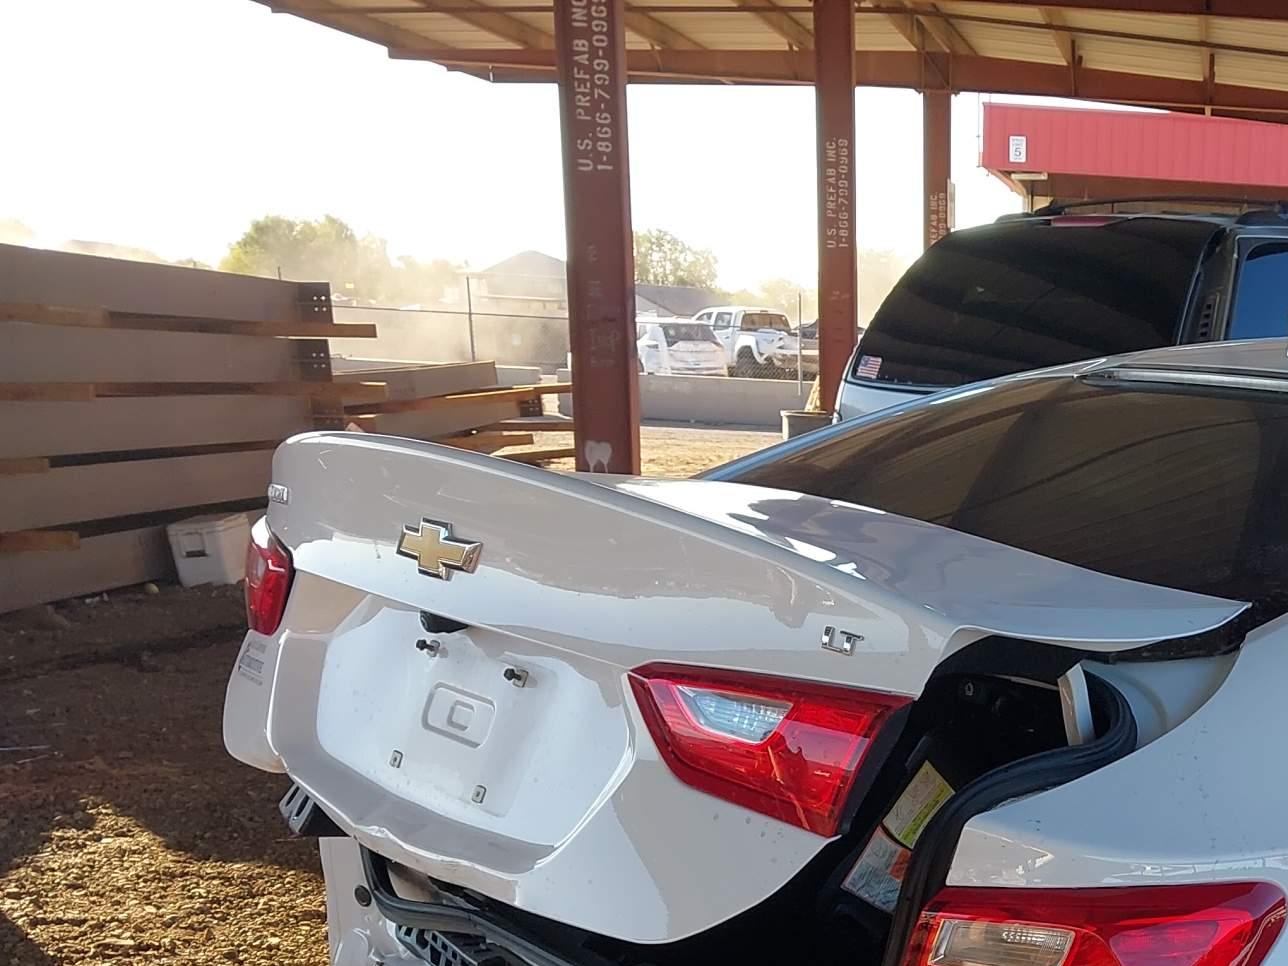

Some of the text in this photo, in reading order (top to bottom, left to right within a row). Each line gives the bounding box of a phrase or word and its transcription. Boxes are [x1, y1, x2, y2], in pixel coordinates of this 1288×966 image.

[572, 39, 592, 121] PREFAB
[591, 0, 614, 170] 1-866-799-096
[577, 132, 594, 171] U.S.
[1014, 147, 1022, 157] 5
[826, 137, 837, 249] U.S. PREFAB INC.
[838, 138, 849, 248] 1-866-799-0969
[821, 625, 865, 657] LT
